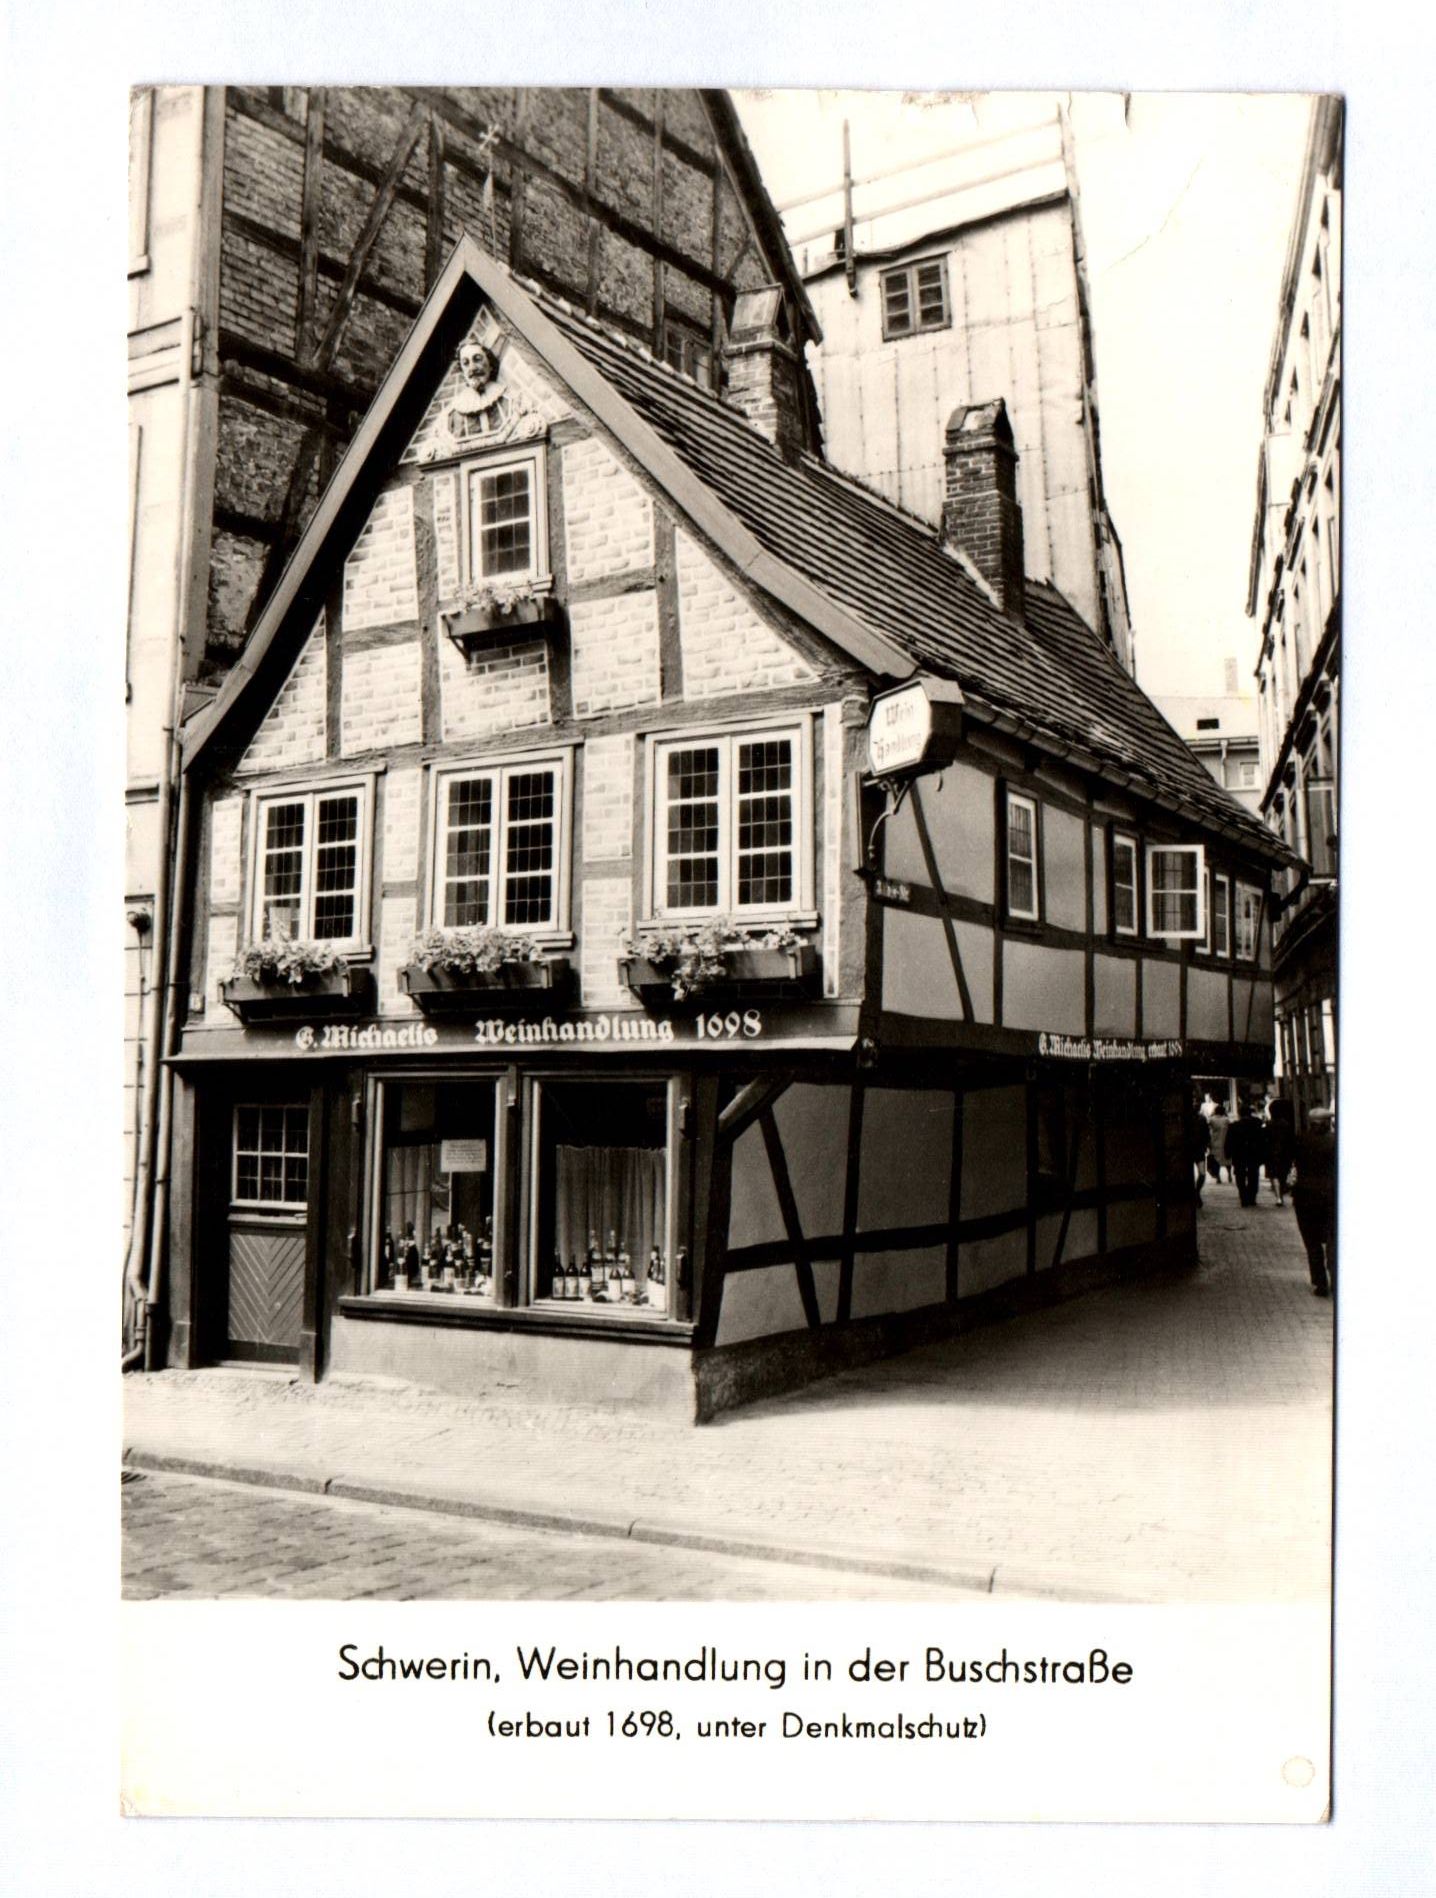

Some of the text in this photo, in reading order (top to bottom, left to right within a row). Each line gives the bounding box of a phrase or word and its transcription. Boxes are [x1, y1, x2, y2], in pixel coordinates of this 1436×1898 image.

[321, 1022, 439, 1049] Michaelis
[474, 1014, 675, 1045] Weinhandlung
[695, 1009, 762, 1040] 1698
